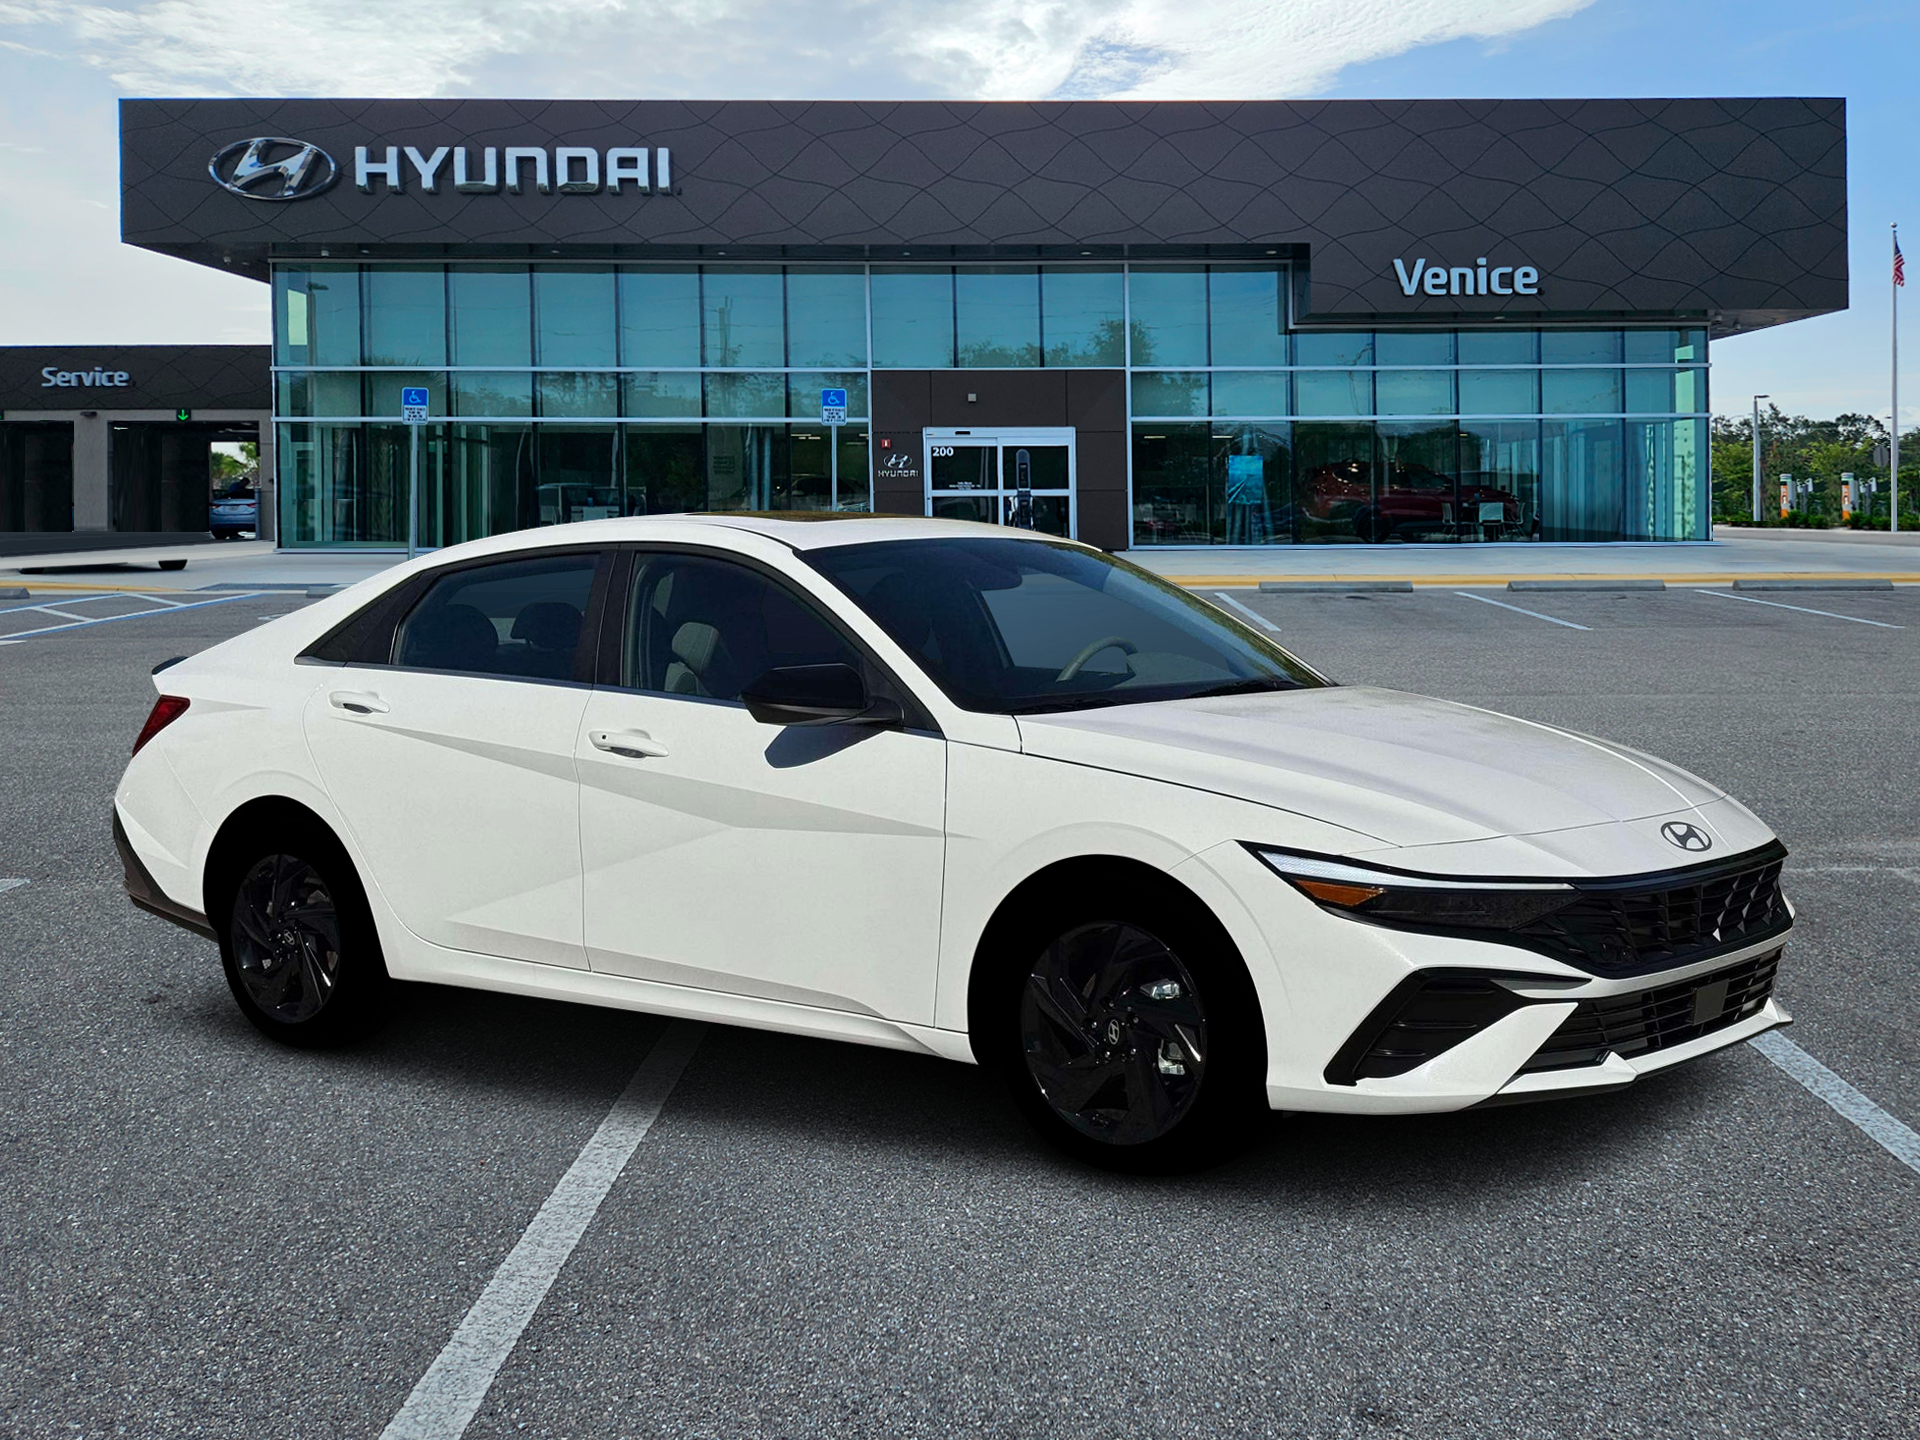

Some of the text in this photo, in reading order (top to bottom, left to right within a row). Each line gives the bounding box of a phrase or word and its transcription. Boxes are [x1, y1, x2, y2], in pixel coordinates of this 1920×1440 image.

[355, 146, 671, 194] HYUNDAI
[1393, 257, 1538, 296] Venice
[41, 366, 130, 388] Service
[932, 446, 954, 457] 200
